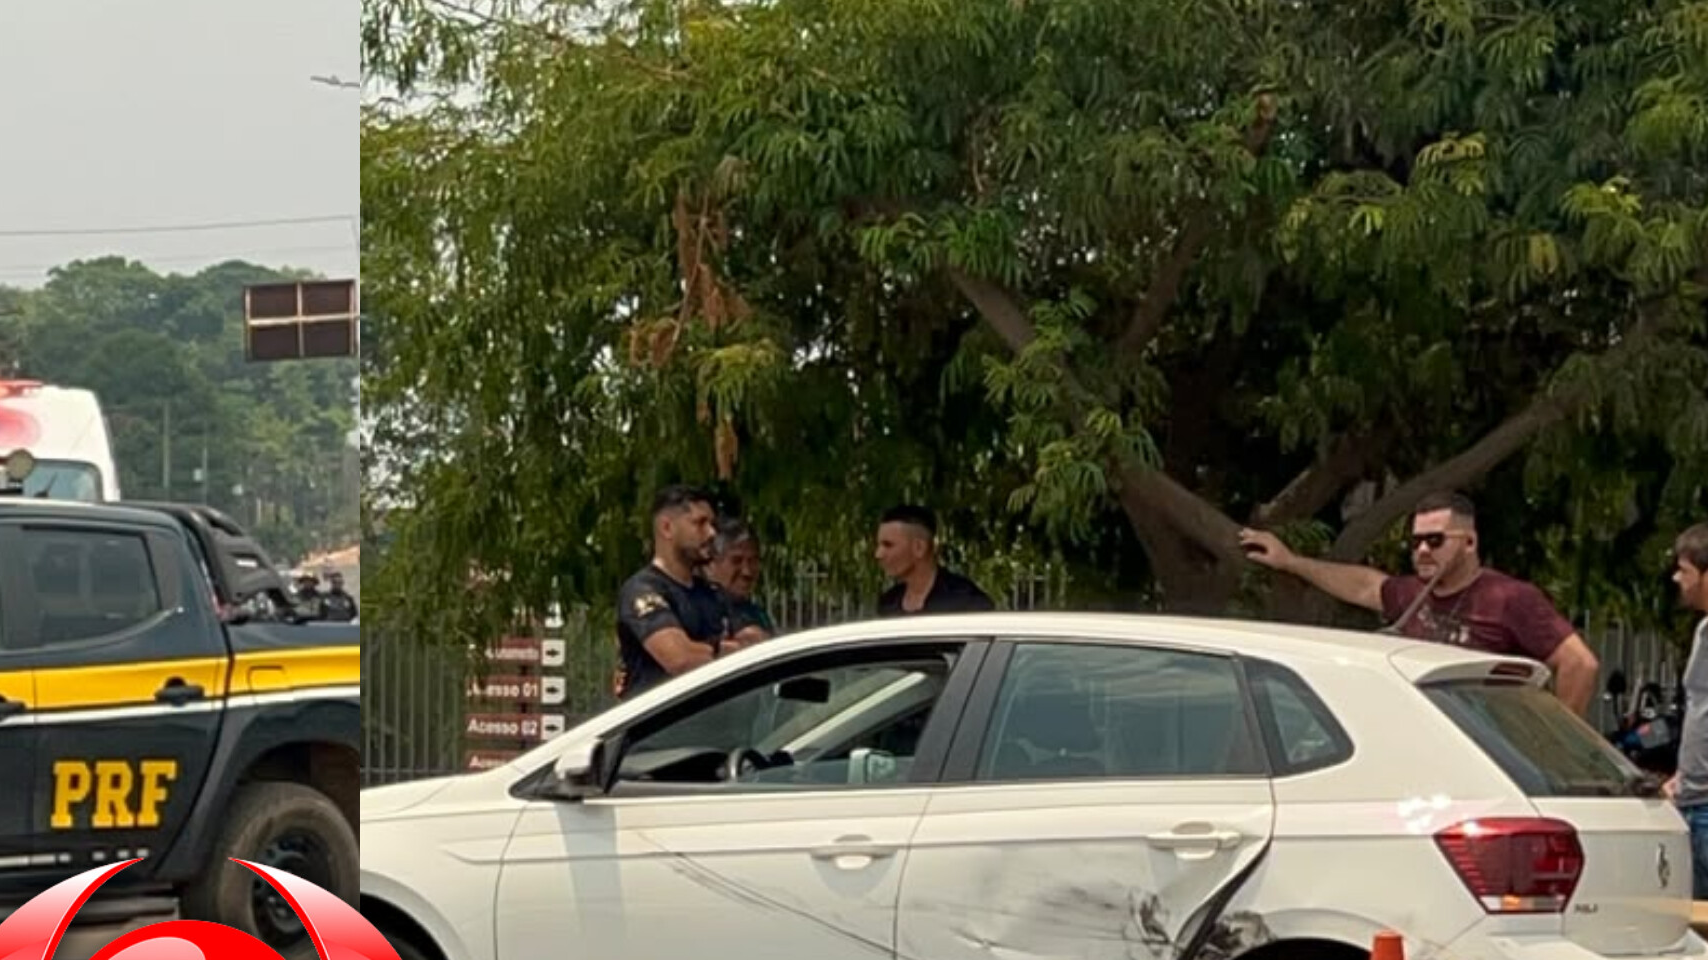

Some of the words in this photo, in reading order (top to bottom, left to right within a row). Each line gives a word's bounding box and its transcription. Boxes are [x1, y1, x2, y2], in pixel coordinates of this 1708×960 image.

[522, 681, 538, 697] 01
[467, 718, 519, 734] Acesso
[520, 719, 538, 735] 02
[51, 761, 177, 828] PRF
